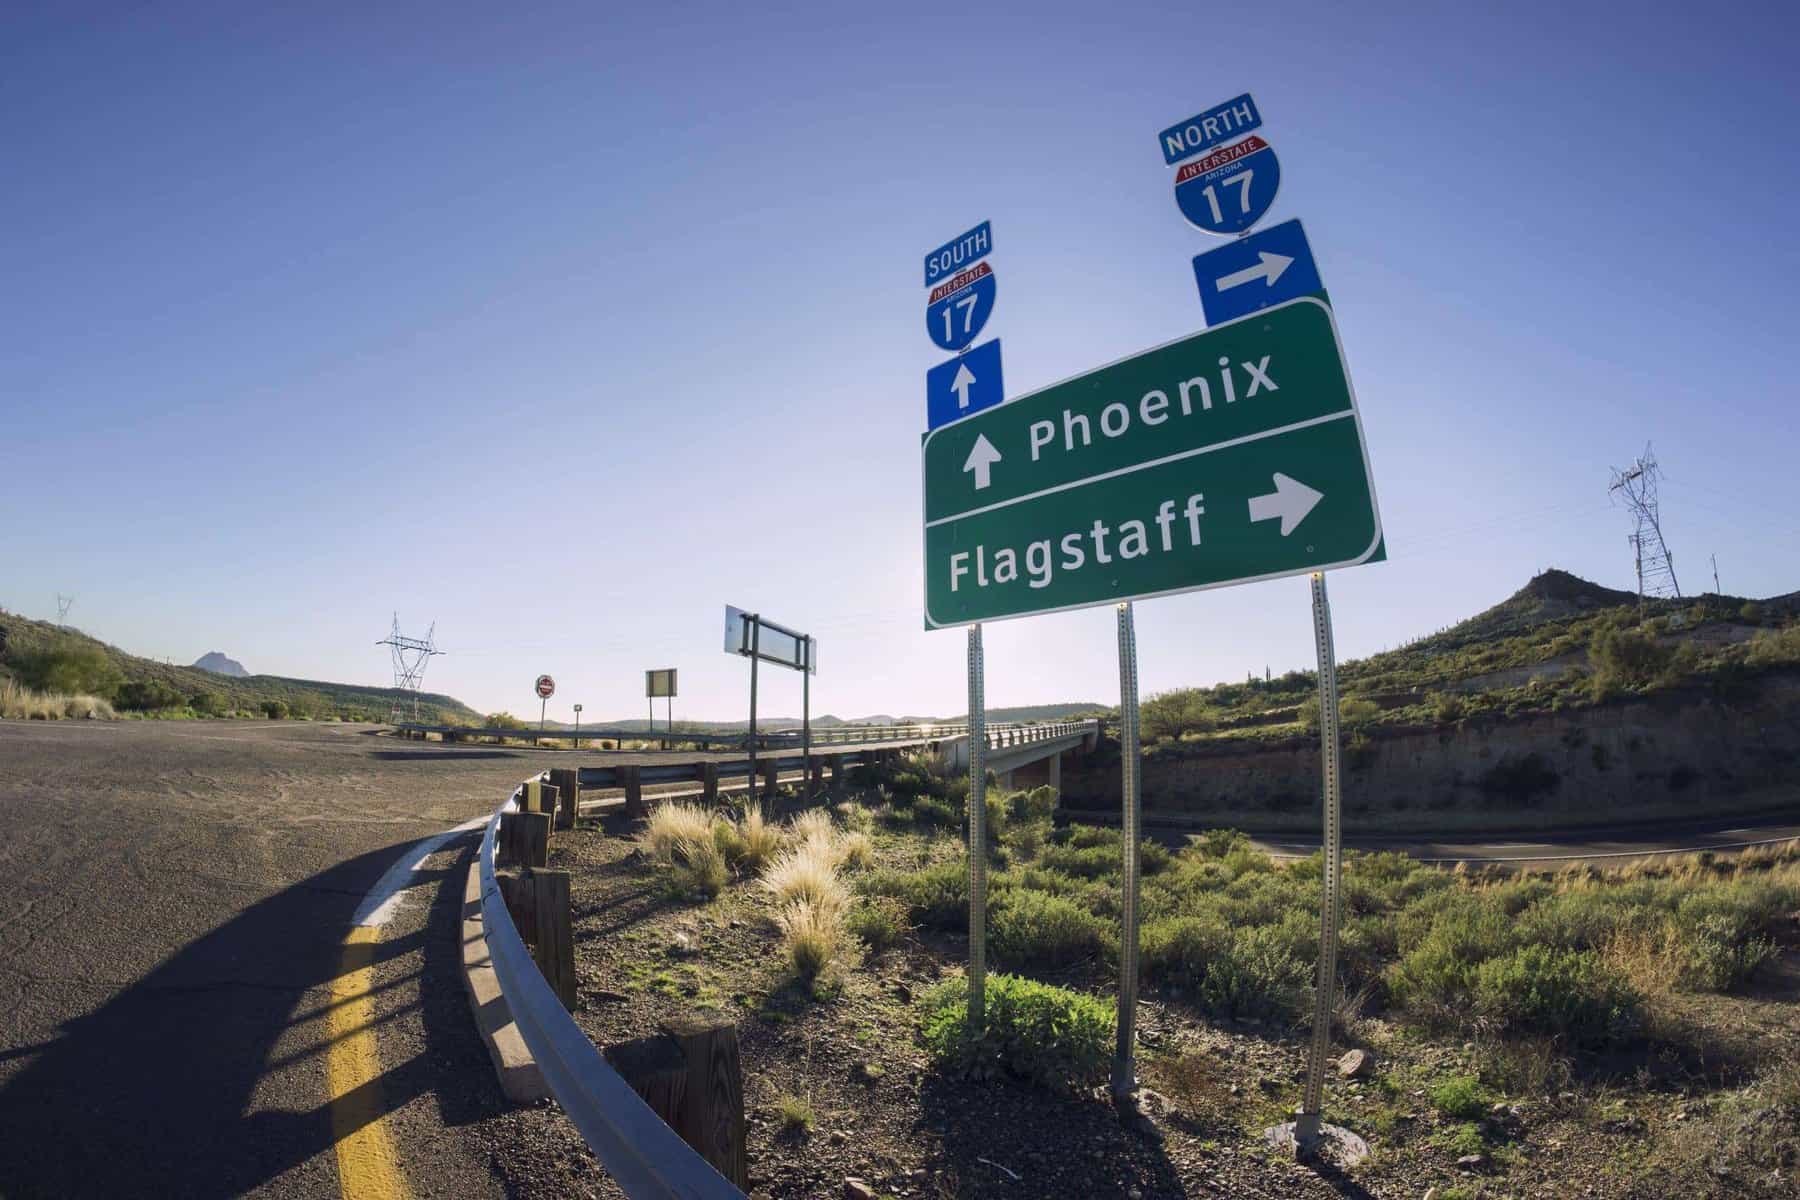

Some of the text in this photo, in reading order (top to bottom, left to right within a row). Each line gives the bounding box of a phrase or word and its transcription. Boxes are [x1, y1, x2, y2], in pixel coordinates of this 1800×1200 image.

[1166, 102, 1253, 156] NORTH
[1184, 141, 1256, 177] INTERSTATE
[1205, 161, 1243, 182] ARIZONA
[1202, 168, 1254, 224] 17
[929, 229, 987, 277] SOUTH
[934, 265, 985, 300] INTERSTATE
[942, 293, 978, 342] 17
[1030, 355, 1279, 461] Phoenix
[950, 494, 1205, 591] Flagstaff
